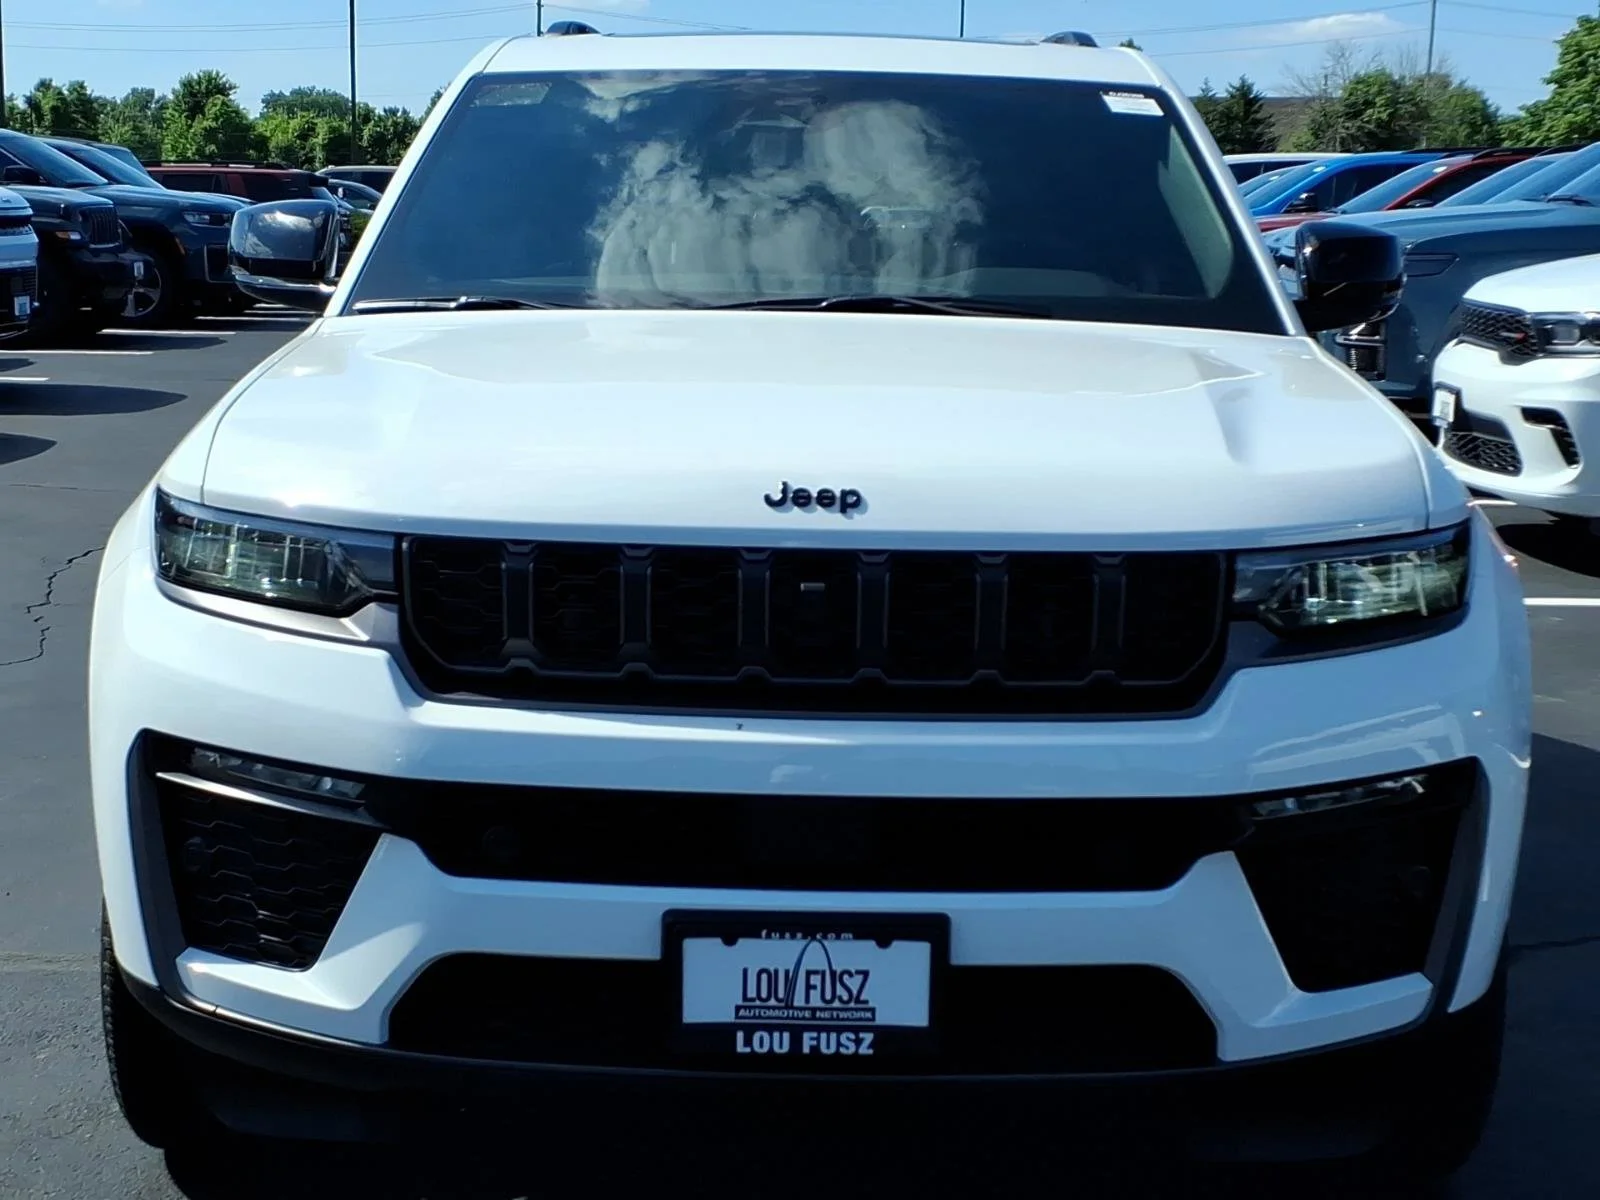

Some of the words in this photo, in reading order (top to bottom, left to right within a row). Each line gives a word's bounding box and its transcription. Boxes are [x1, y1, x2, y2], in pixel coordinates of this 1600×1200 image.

[763, 480, 863, 514] Jeep
[741, 967, 790, 1004] LOU
[804, 969, 870, 1006] FUSZ
[738, 1007, 812, 1018] AUTOMOTIVE
[816, 1009, 873, 1019] NETWORK
[736, 1030, 790, 1054] LOU
[802, 1031, 874, 1055] FUSZ
